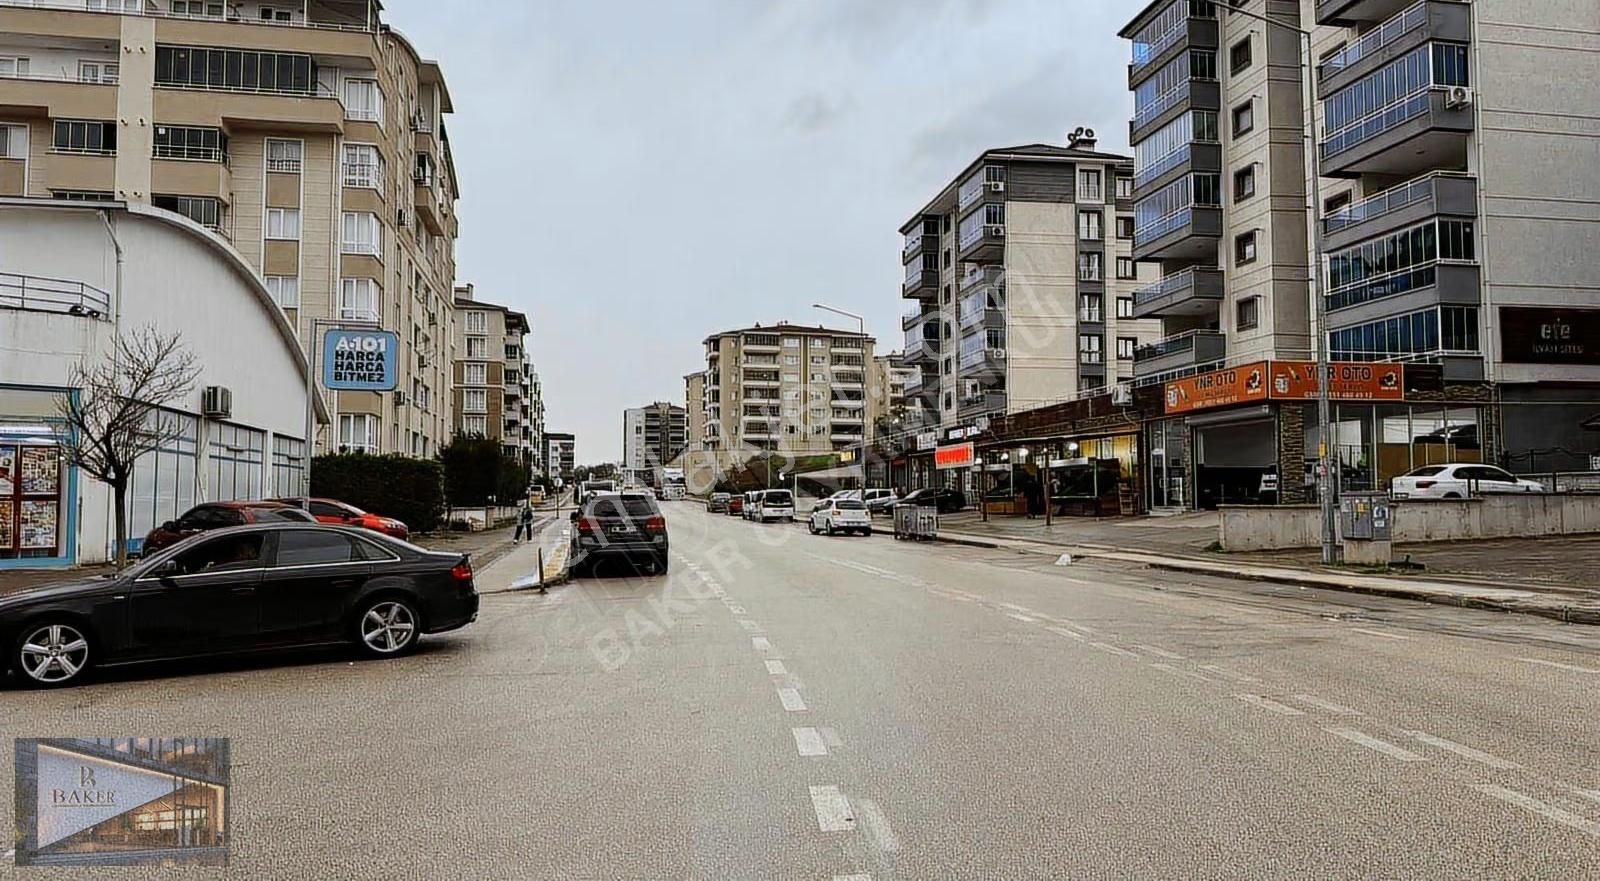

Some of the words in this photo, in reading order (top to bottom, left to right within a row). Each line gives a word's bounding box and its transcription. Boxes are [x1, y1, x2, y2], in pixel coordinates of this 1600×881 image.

[335, 350, 385, 362] HARCA
[335, 361, 385, 372] HARCA
[1342, 365, 1373, 381] OTO
[1216, 371, 1237, 386] OTO
